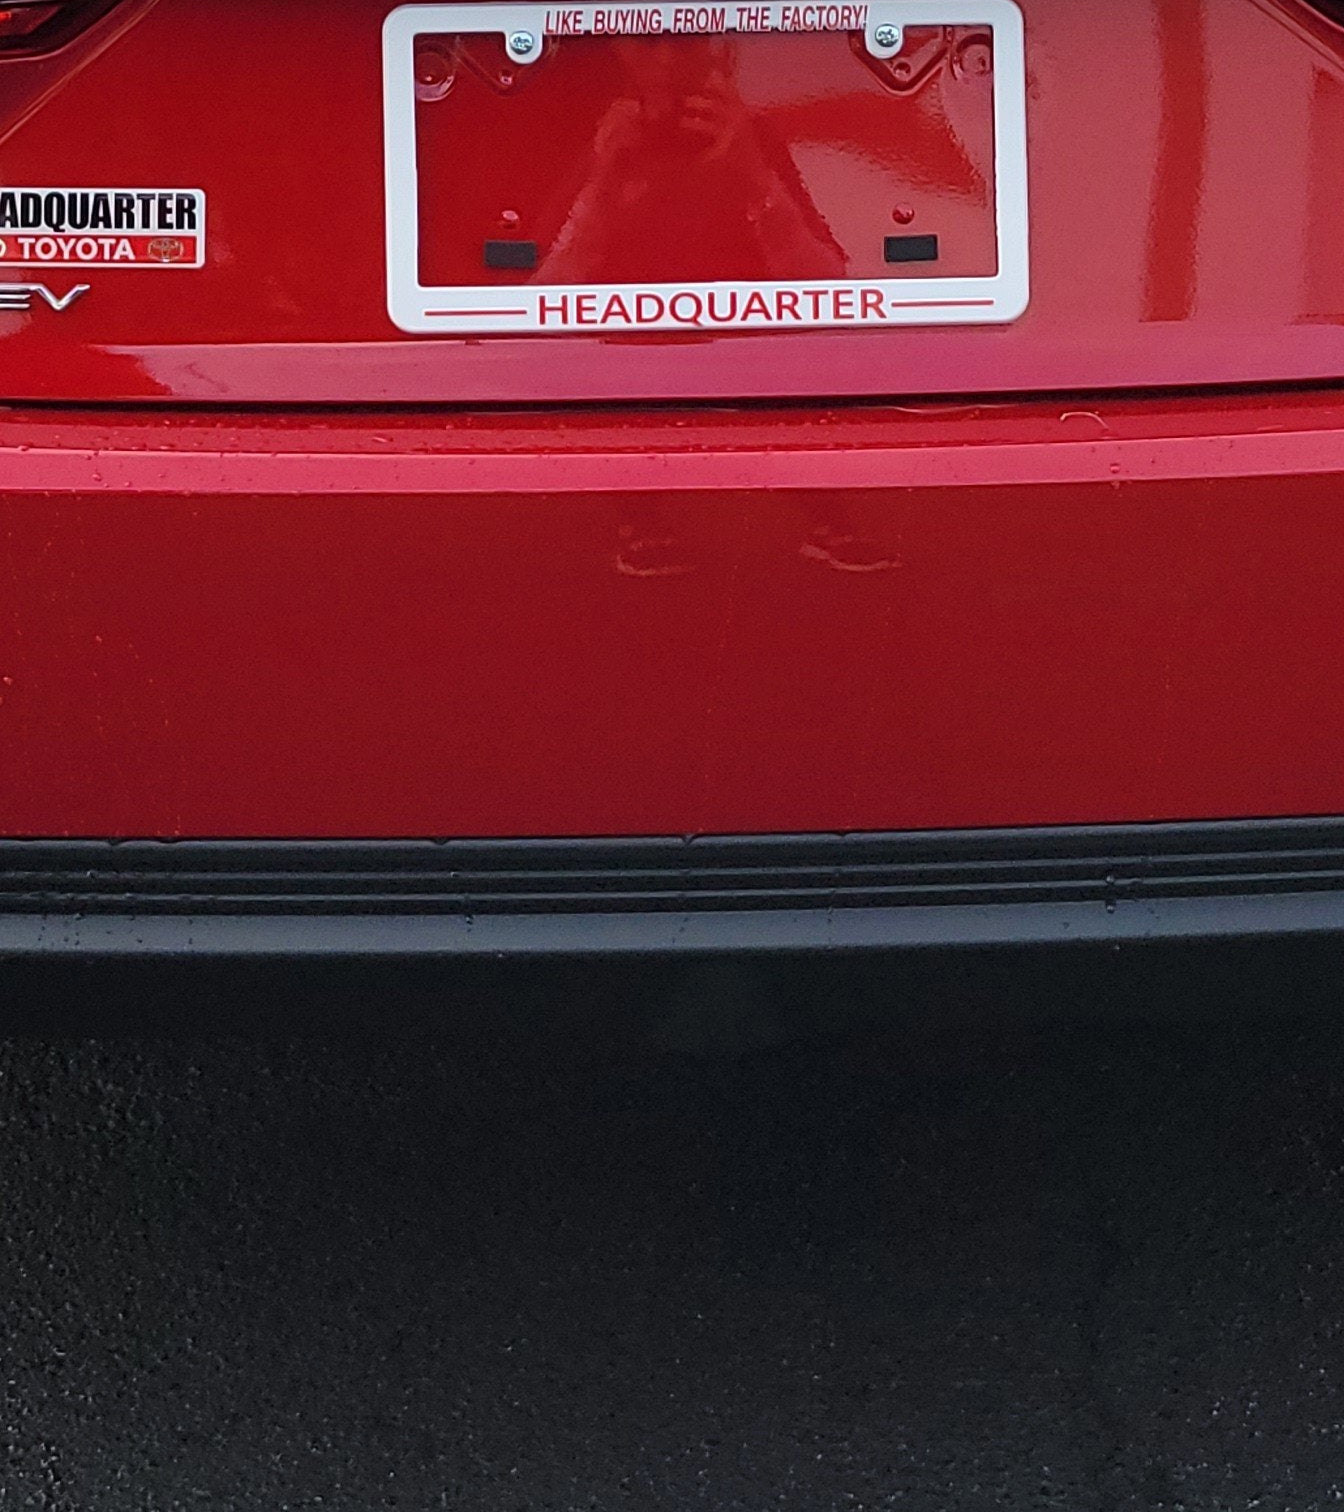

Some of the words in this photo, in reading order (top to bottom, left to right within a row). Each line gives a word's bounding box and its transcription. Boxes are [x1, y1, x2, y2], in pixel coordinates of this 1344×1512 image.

[544, 10, 583, 35] LIKE
[593, 9, 662, 34] BUYING
[673, 7, 726, 32] FROM
[736, 6, 771, 31] THE
[780, 4, 869, 30] FACTORY!
[17, 236, 136, 261] TOYOTA
[537, 289, 888, 327] HEADQUARTER
